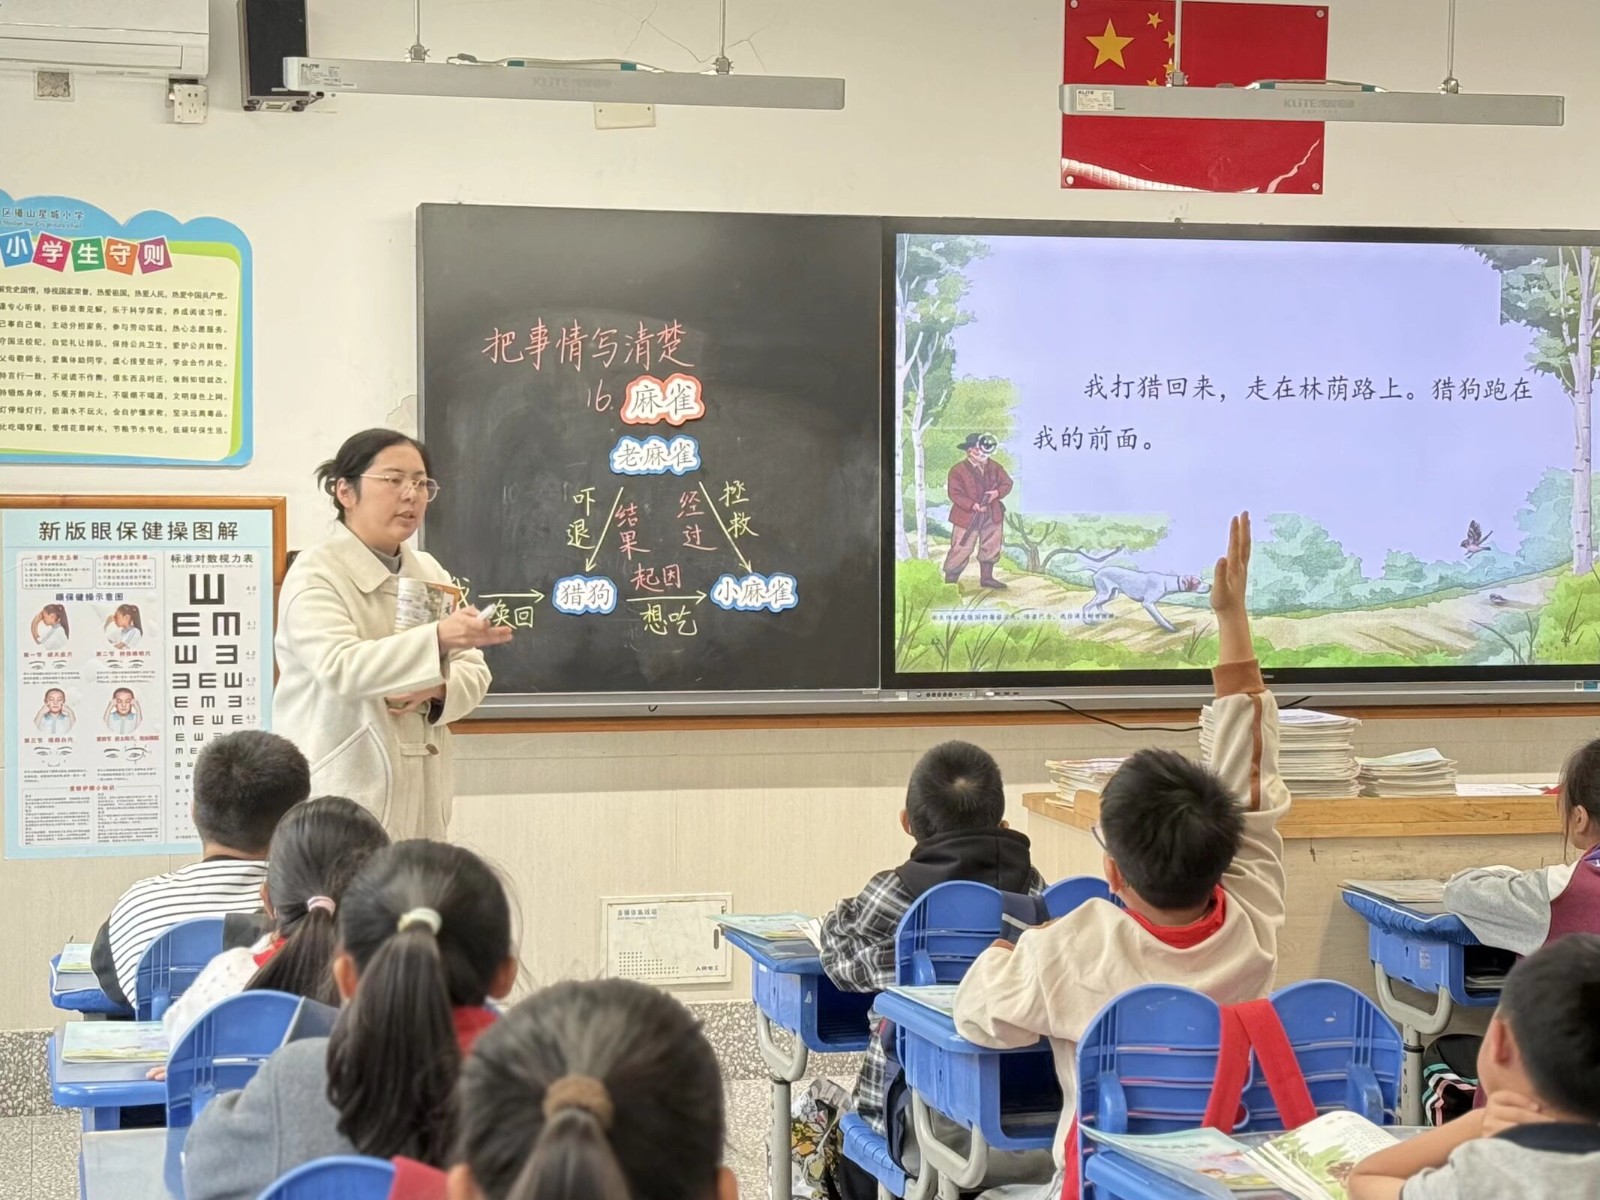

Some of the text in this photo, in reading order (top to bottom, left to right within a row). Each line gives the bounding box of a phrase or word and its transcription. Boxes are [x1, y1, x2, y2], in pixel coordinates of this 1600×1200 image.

[6, 235, 165, 267] 小学生守则
[481, 317, 695, 372] 把事情写清楚
[631, 382, 696, 415] 麻雀
[1083, 373, 1534, 404] 我打猎回来，走在林荫路上。猎狗跑在
[618, 438, 695, 467] 老麻雀
[1033, 425, 1156, 452] 我的前面。
[566, 487, 596, 550] 吓退
[676, 491, 717, 550] 经过
[719, 480, 759, 538] 拯救
[39, 521, 239, 542] 新版眼保健操图解
[615, 503, 651, 560] 结果
[171, 554, 253, 564] 标准对数视力表
[631, 564, 682, 593] 起因
[716, 580, 790, 608] 小麻雀
[561, 582, 611, 608] 猎狗
[643, 605, 697, 636] 想吃
